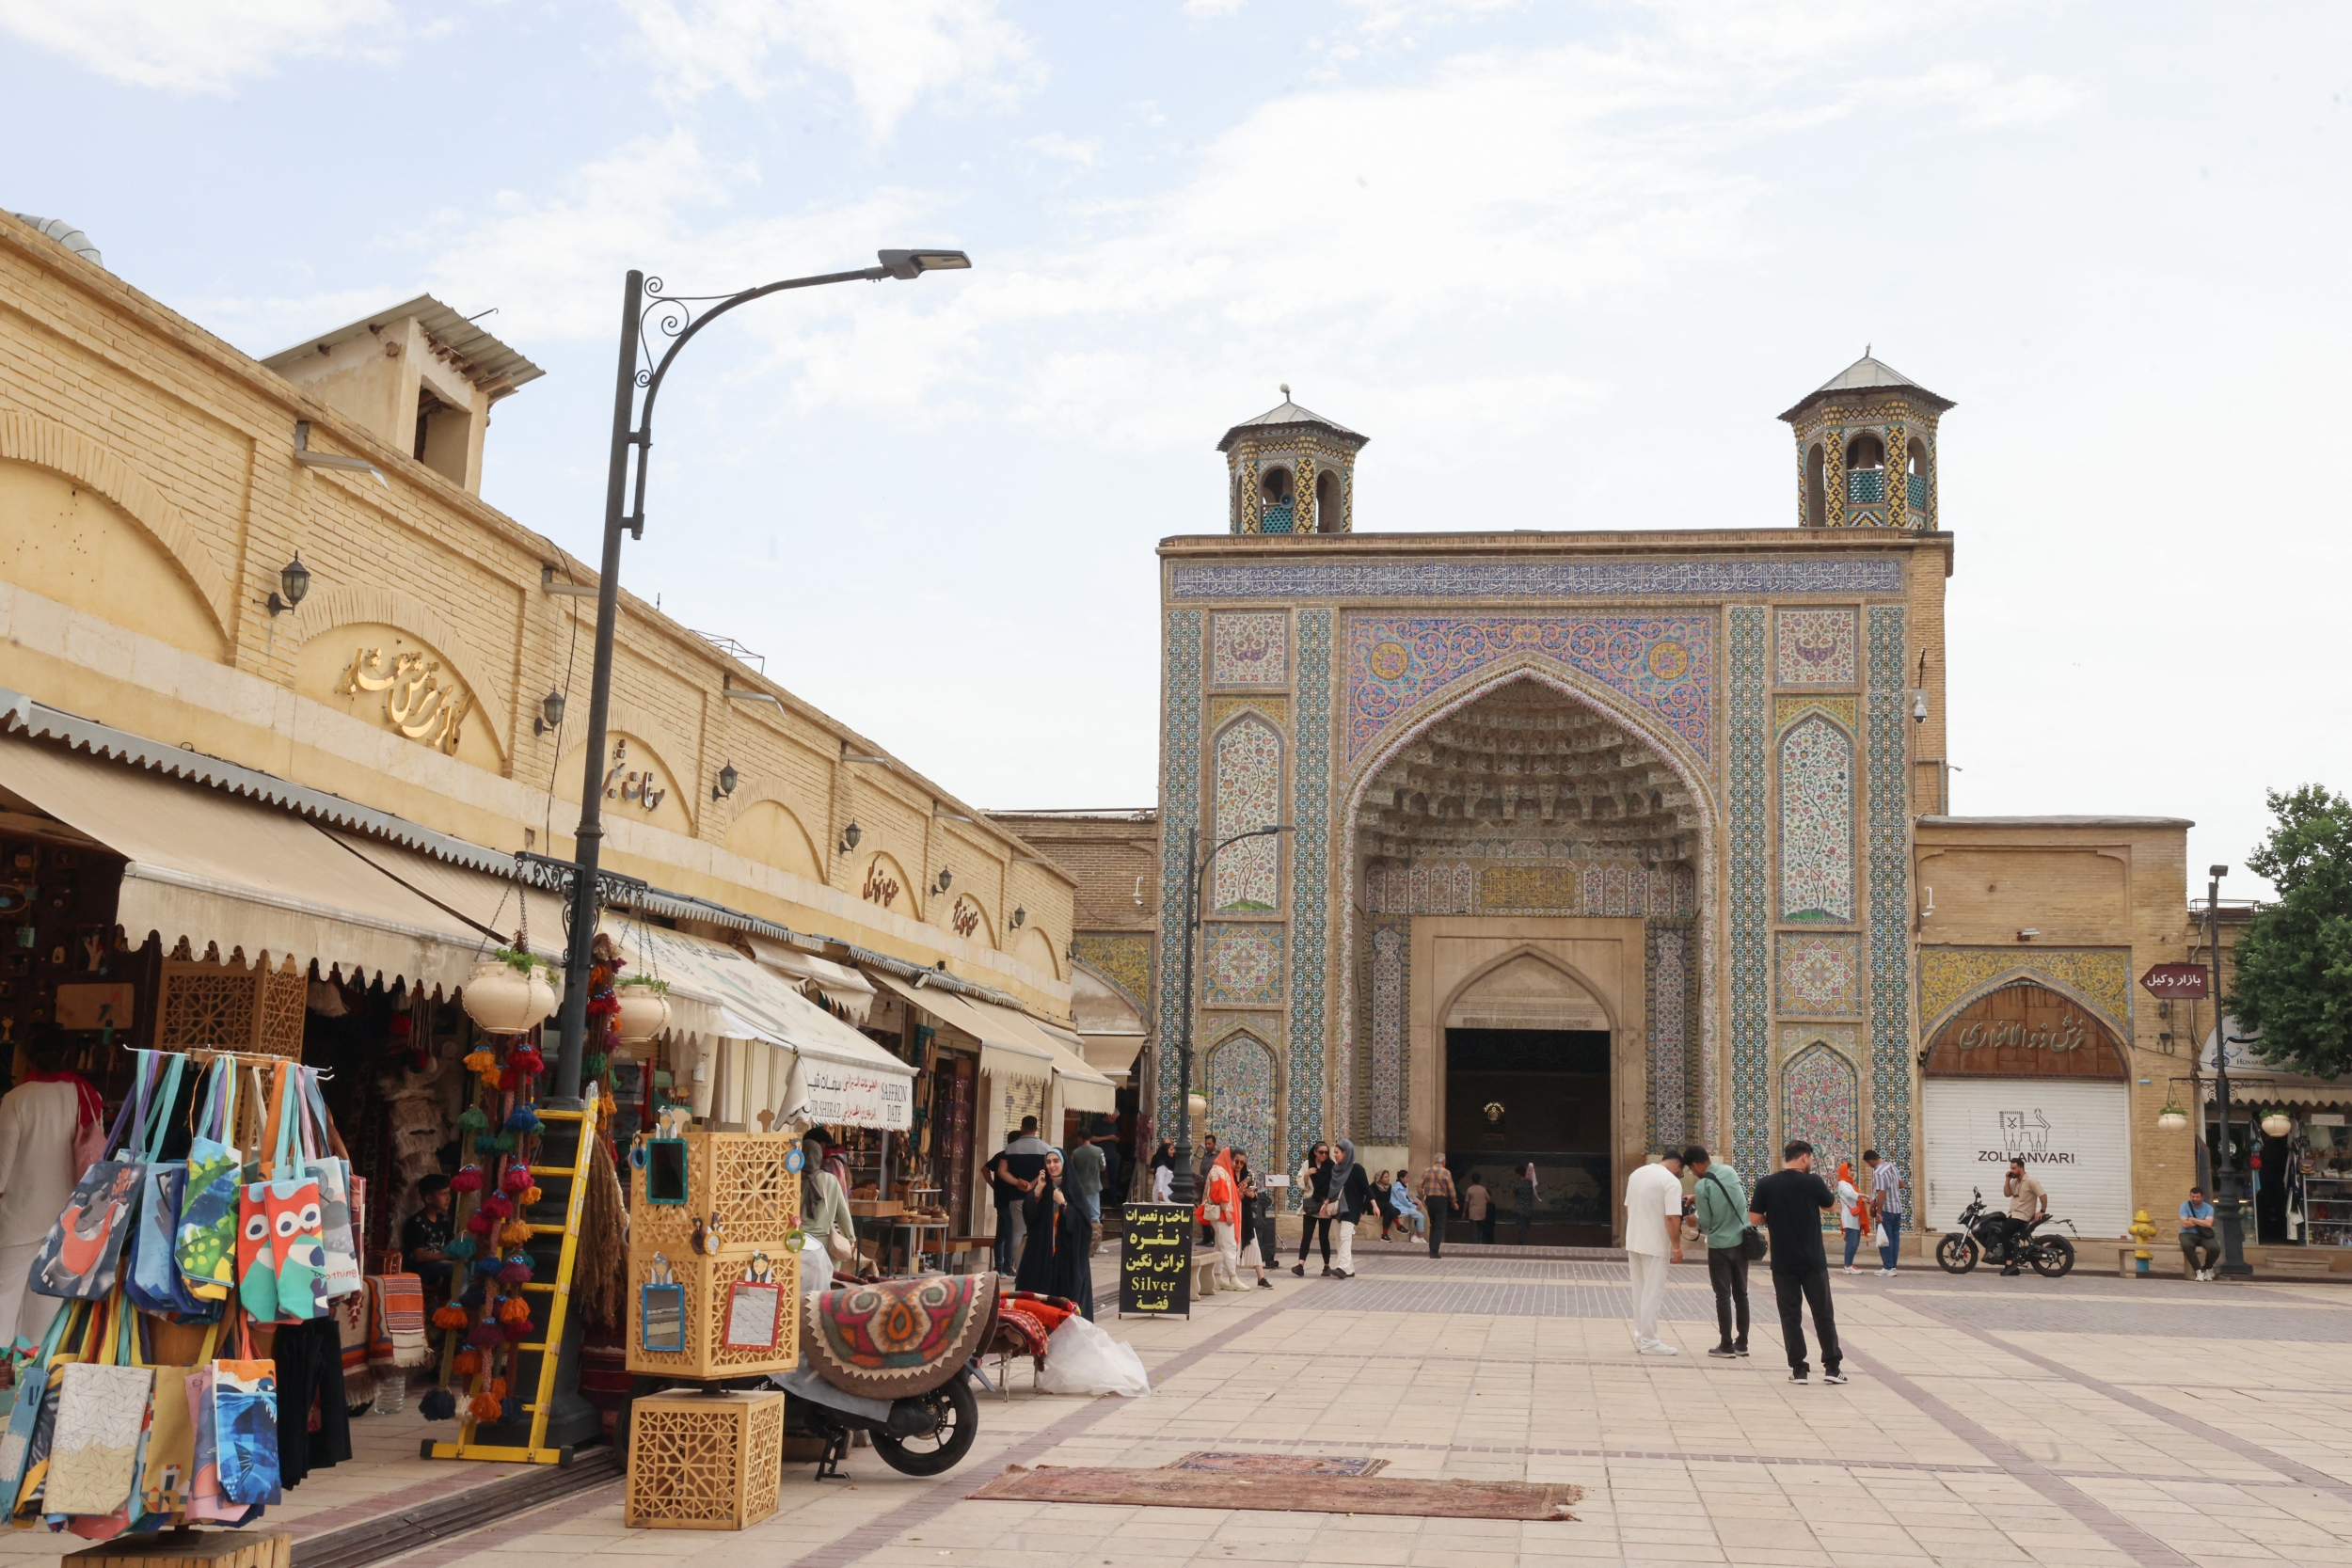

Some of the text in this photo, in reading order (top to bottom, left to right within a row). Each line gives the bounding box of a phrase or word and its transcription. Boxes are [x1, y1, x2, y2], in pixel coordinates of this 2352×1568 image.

[335, 647, 411, 693] عشایر
[387, 651, 440, 723] فرش
[2147, 974, 2201, 987] بازار وکیل
[2050, 1015, 2086, 1053] فرش
[881, 1083, 908, 1102] SAFFRON
[818, 1101, 841, 1118] SHIRAZ
[887, 1104, 902, 1122] DATE
[1978, 1150, 2075, 1164] ZOLLANVARI
[1125, 1209, 1190, 1226] ساخت و تعمیرات
[1129, 1228, 1180, 1250] نقره
[1125, 1253, 1184, 1273] تراش نگین
[1131, 1276, 1176, 1291] Silver
